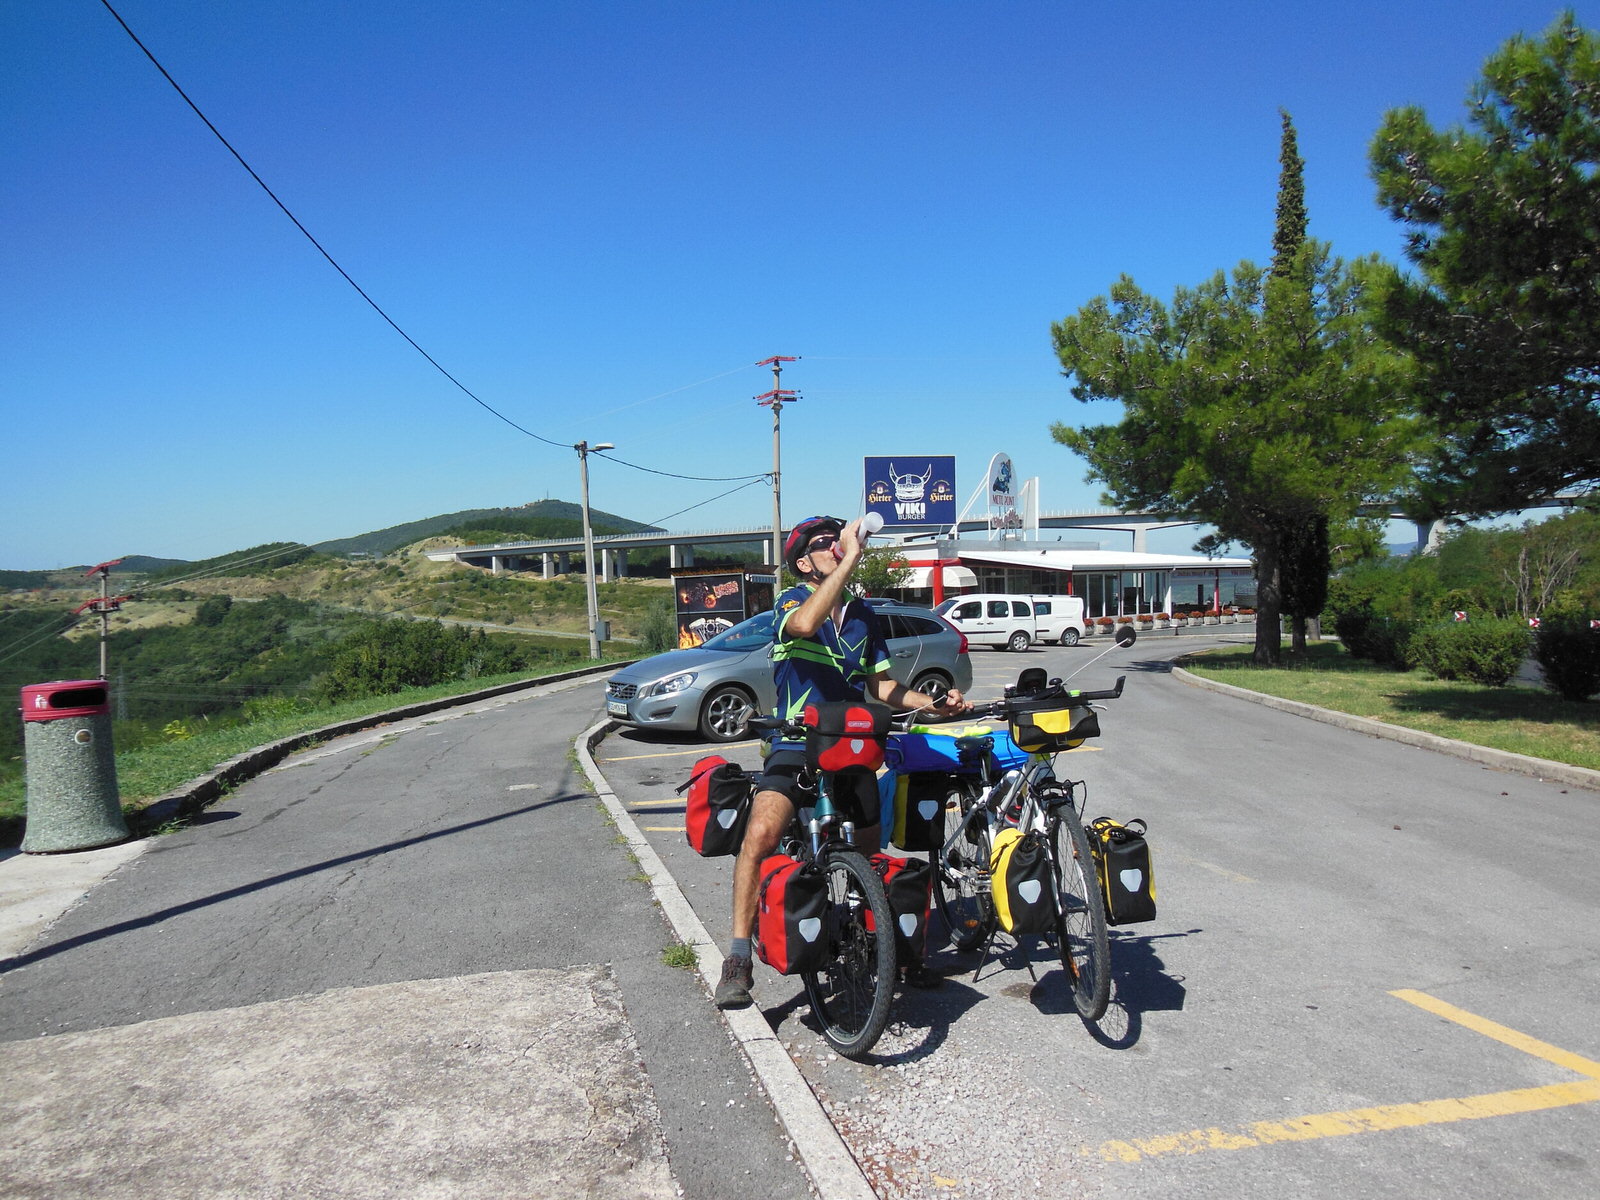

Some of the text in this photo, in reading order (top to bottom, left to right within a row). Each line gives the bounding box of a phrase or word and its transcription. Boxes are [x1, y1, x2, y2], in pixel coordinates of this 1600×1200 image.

[868, 493, 892, 504] Hirter
[930, 492, 954, 504] Hirter
[894, 502, 926, 514] VIKI
